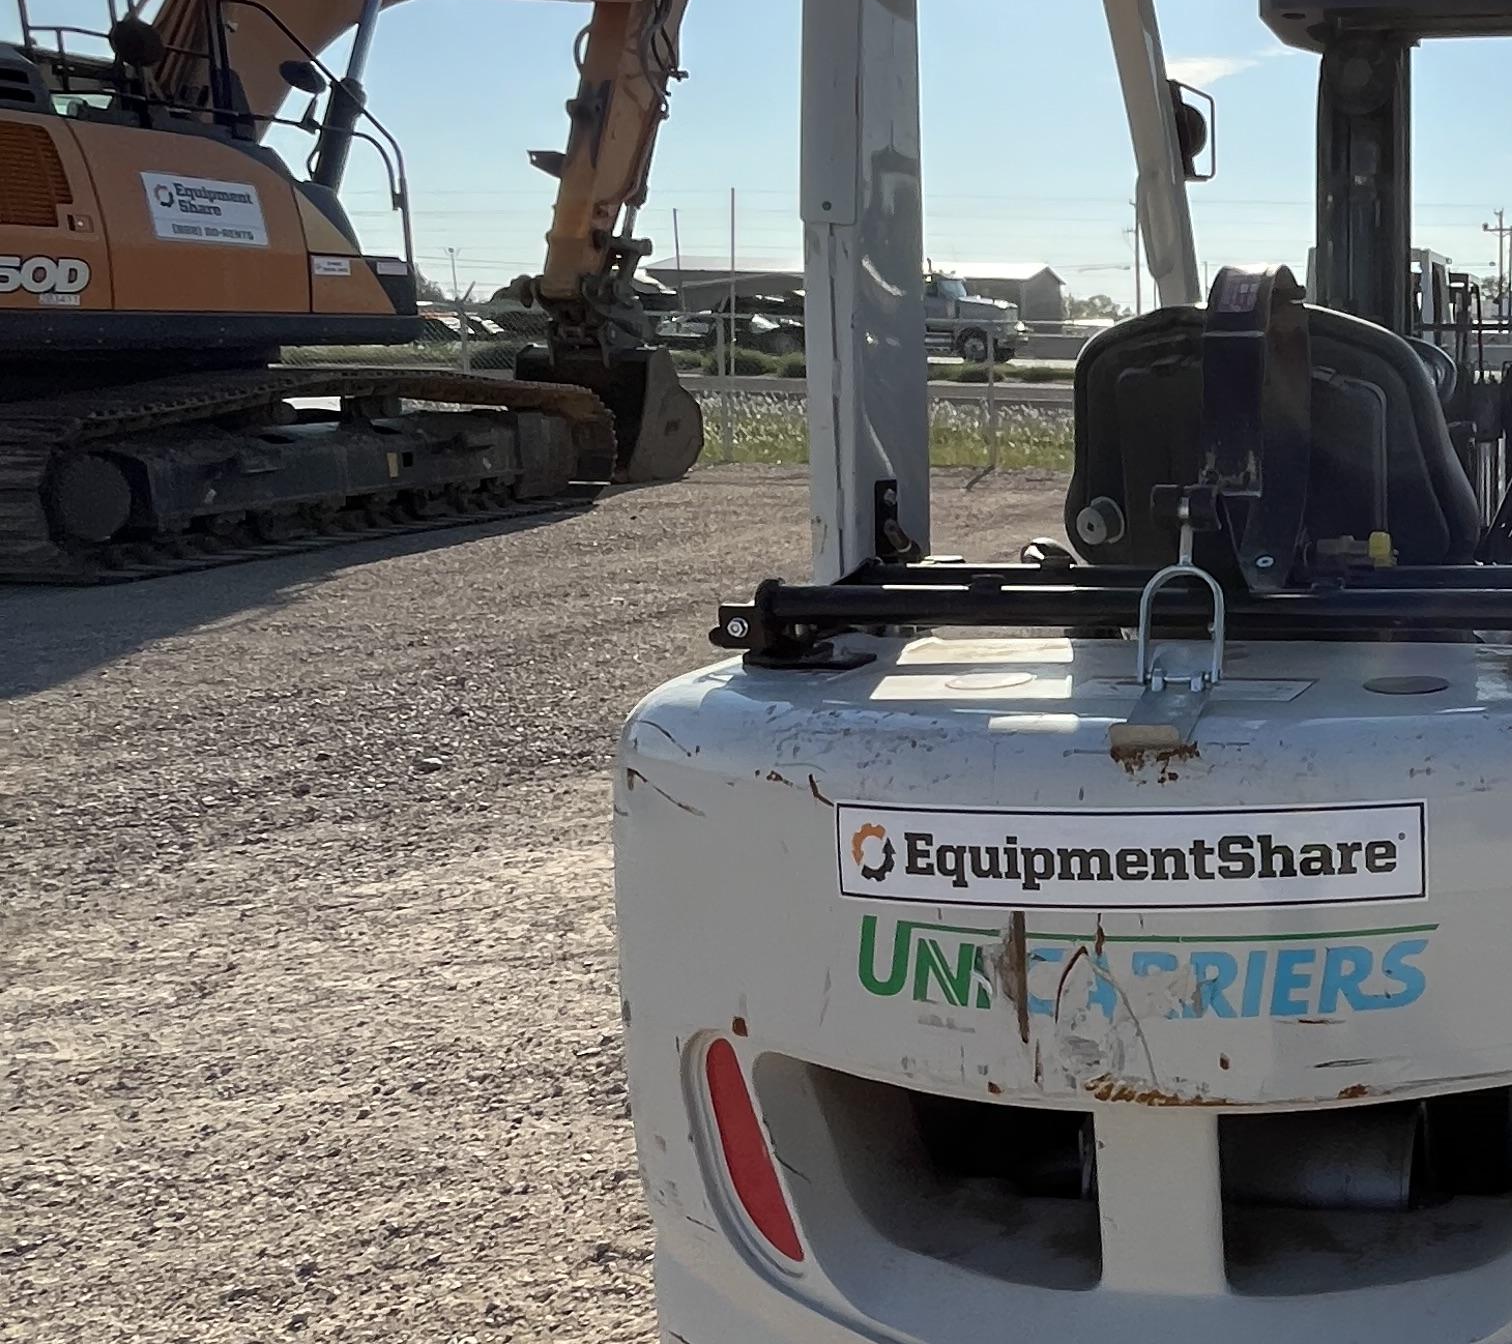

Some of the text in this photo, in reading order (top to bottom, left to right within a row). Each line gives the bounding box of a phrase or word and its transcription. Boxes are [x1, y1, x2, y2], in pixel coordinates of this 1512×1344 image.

[173, 182, 254, 205] Equipment
[178, 199, 222, 217] Share
[903, 832, 1398, 891] EquipmentShare
